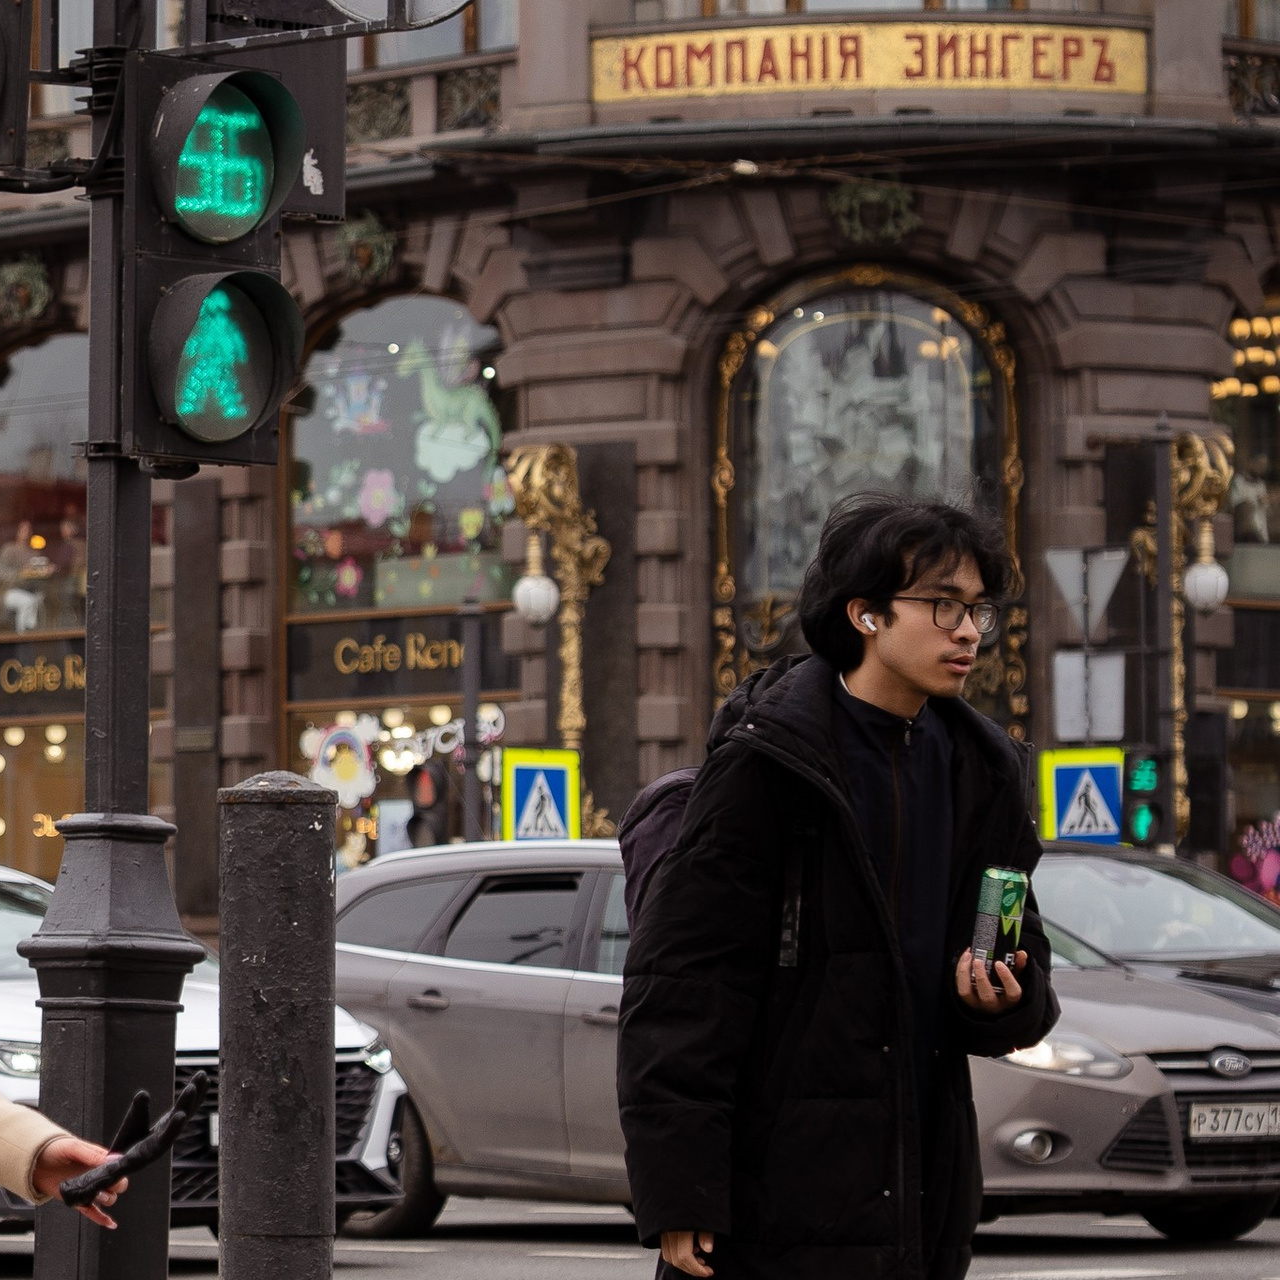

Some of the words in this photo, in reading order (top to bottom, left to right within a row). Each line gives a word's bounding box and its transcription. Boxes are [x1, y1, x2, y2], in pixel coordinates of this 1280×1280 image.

[621, 32, 865, 91] КОМПАНІЯ
[903, 32, 1117, 83] ЗИНГЕРЪ
[0, 655, 62, 694] Cafe
[334, 634, 402, 675] Cafe
